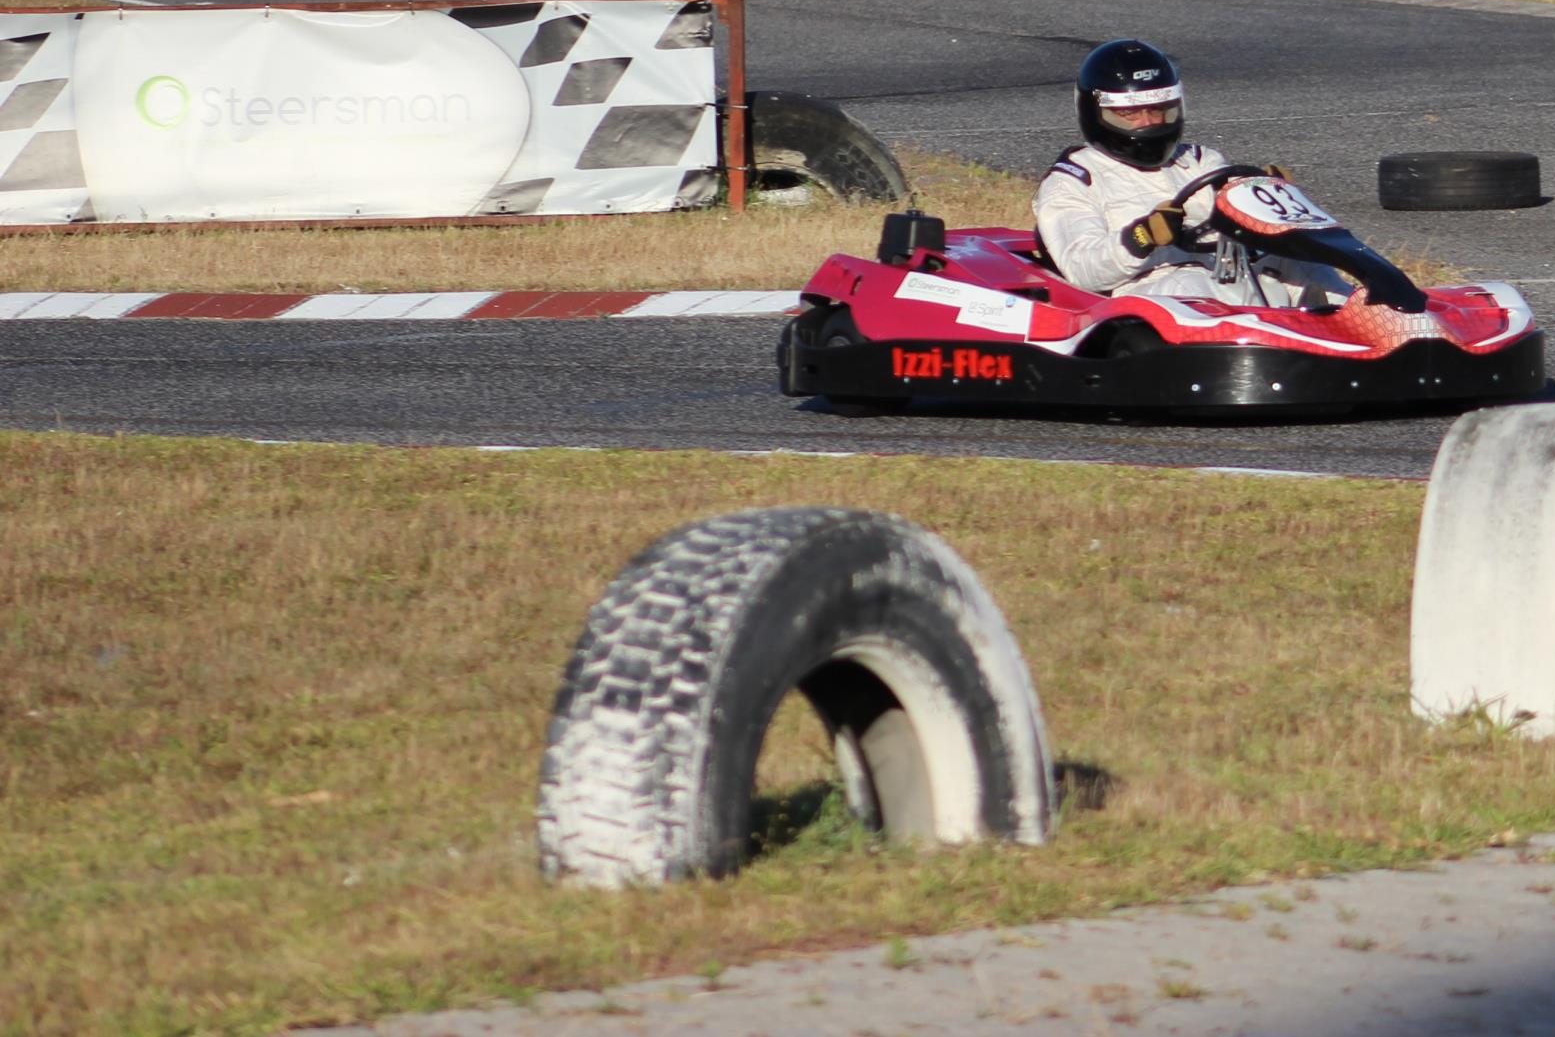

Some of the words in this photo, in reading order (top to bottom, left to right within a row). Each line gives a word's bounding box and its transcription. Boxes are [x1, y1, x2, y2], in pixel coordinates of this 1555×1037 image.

[201, 86, 471, 127] Steersman
[1251, 185, 1310, 215] 93
[892, 346, 1013, 379] Izzi-Flex
